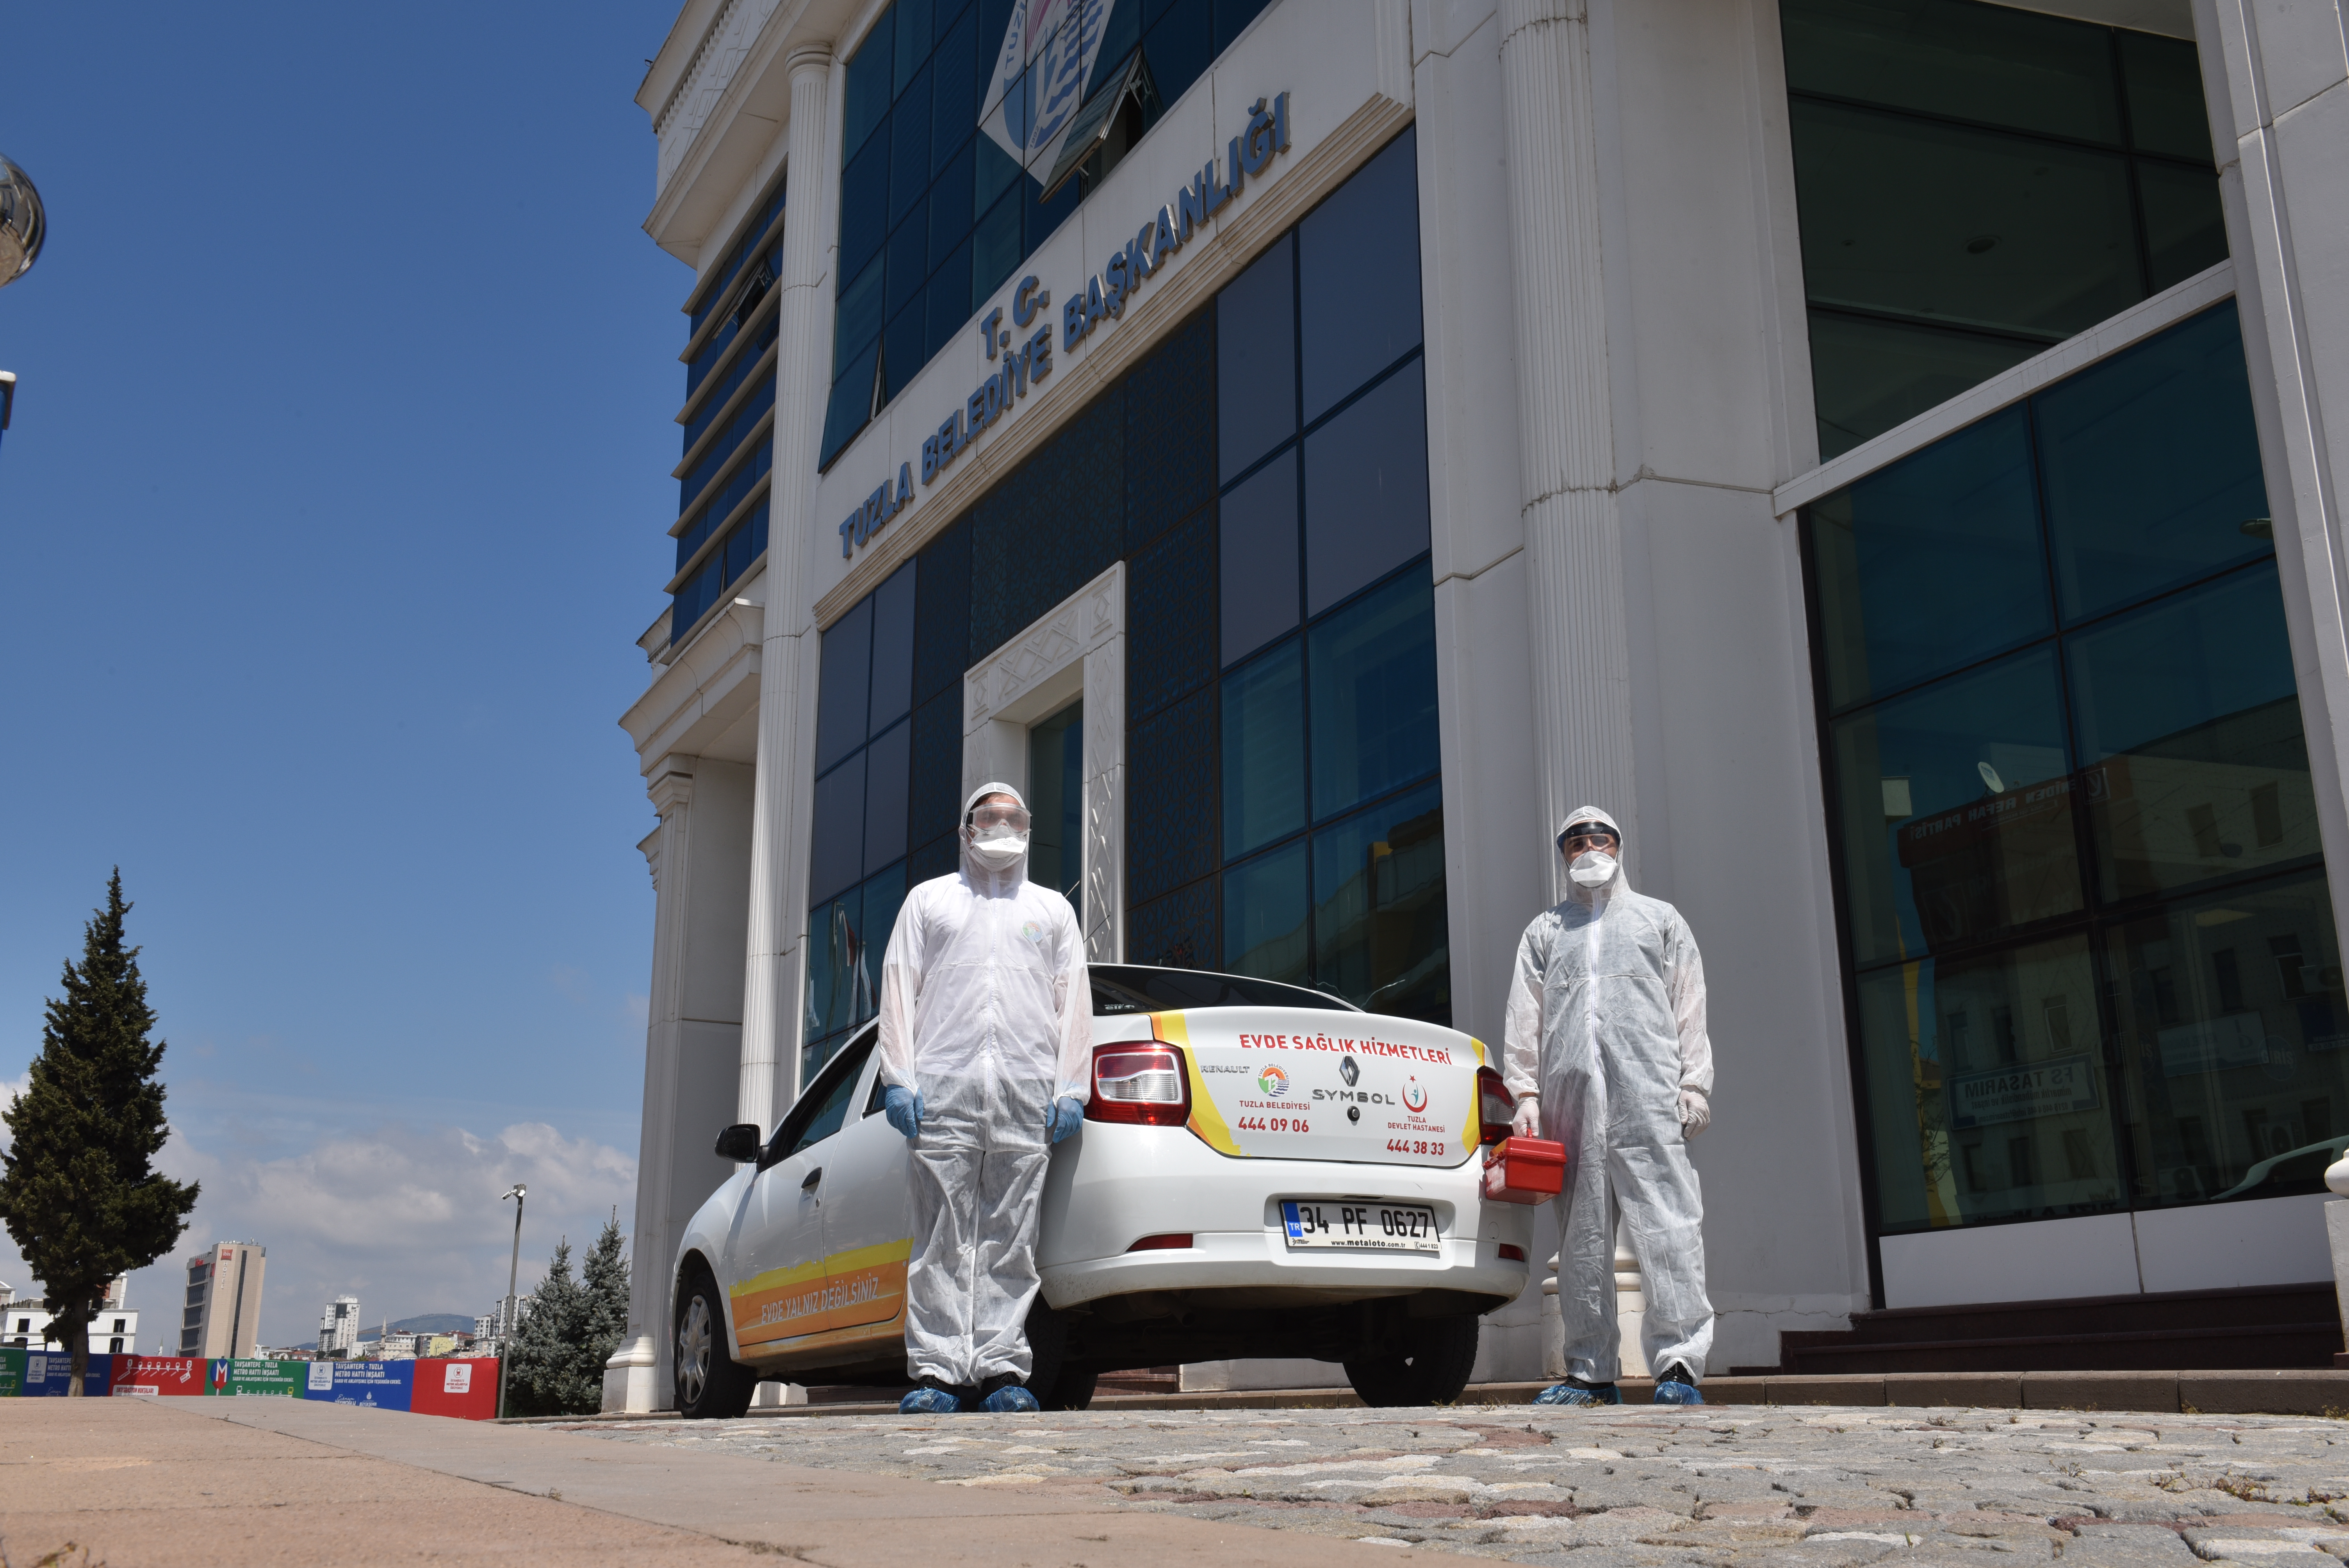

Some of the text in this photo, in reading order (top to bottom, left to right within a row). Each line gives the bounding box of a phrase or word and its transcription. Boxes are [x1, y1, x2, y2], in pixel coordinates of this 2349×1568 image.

[839, 91, 1291, 559] TUZLA BELEDİYE BAŞKANLIĞI
[1239, 1033, 1452, 1065] EVDE SAĞLIK HİZMETLERİ
[2261, 1047, 2294, 1069] GİRİŞ
[1200, 1065, 1250, 1073] RENAULT
[1258, 1065, 1267, 1077] TUZLA
[1312, 1089, 1395, 1105] SYMBOL
[1266, 1101, 1310, 1110] BELEDİYESİ
[1238, 1117, 1309, 1133] 444 09 06
[1413, 1124, 1445, 1133] HASTANESİ
[1387, 1139, 1444, 1156] 444 38 33
[1300, 1206, 1429, 1238] 34 PF 0627
[1331, 1239, 1406, 1248] www.metaloto.com.tr
[761, 1272, 879, 1324] EVDE YALNIZ DEĞİLSİNİZ
[262, 1368, 279, 1376] İNŞAATI
[366, 1370, 385, 1379] İNŞAATI
